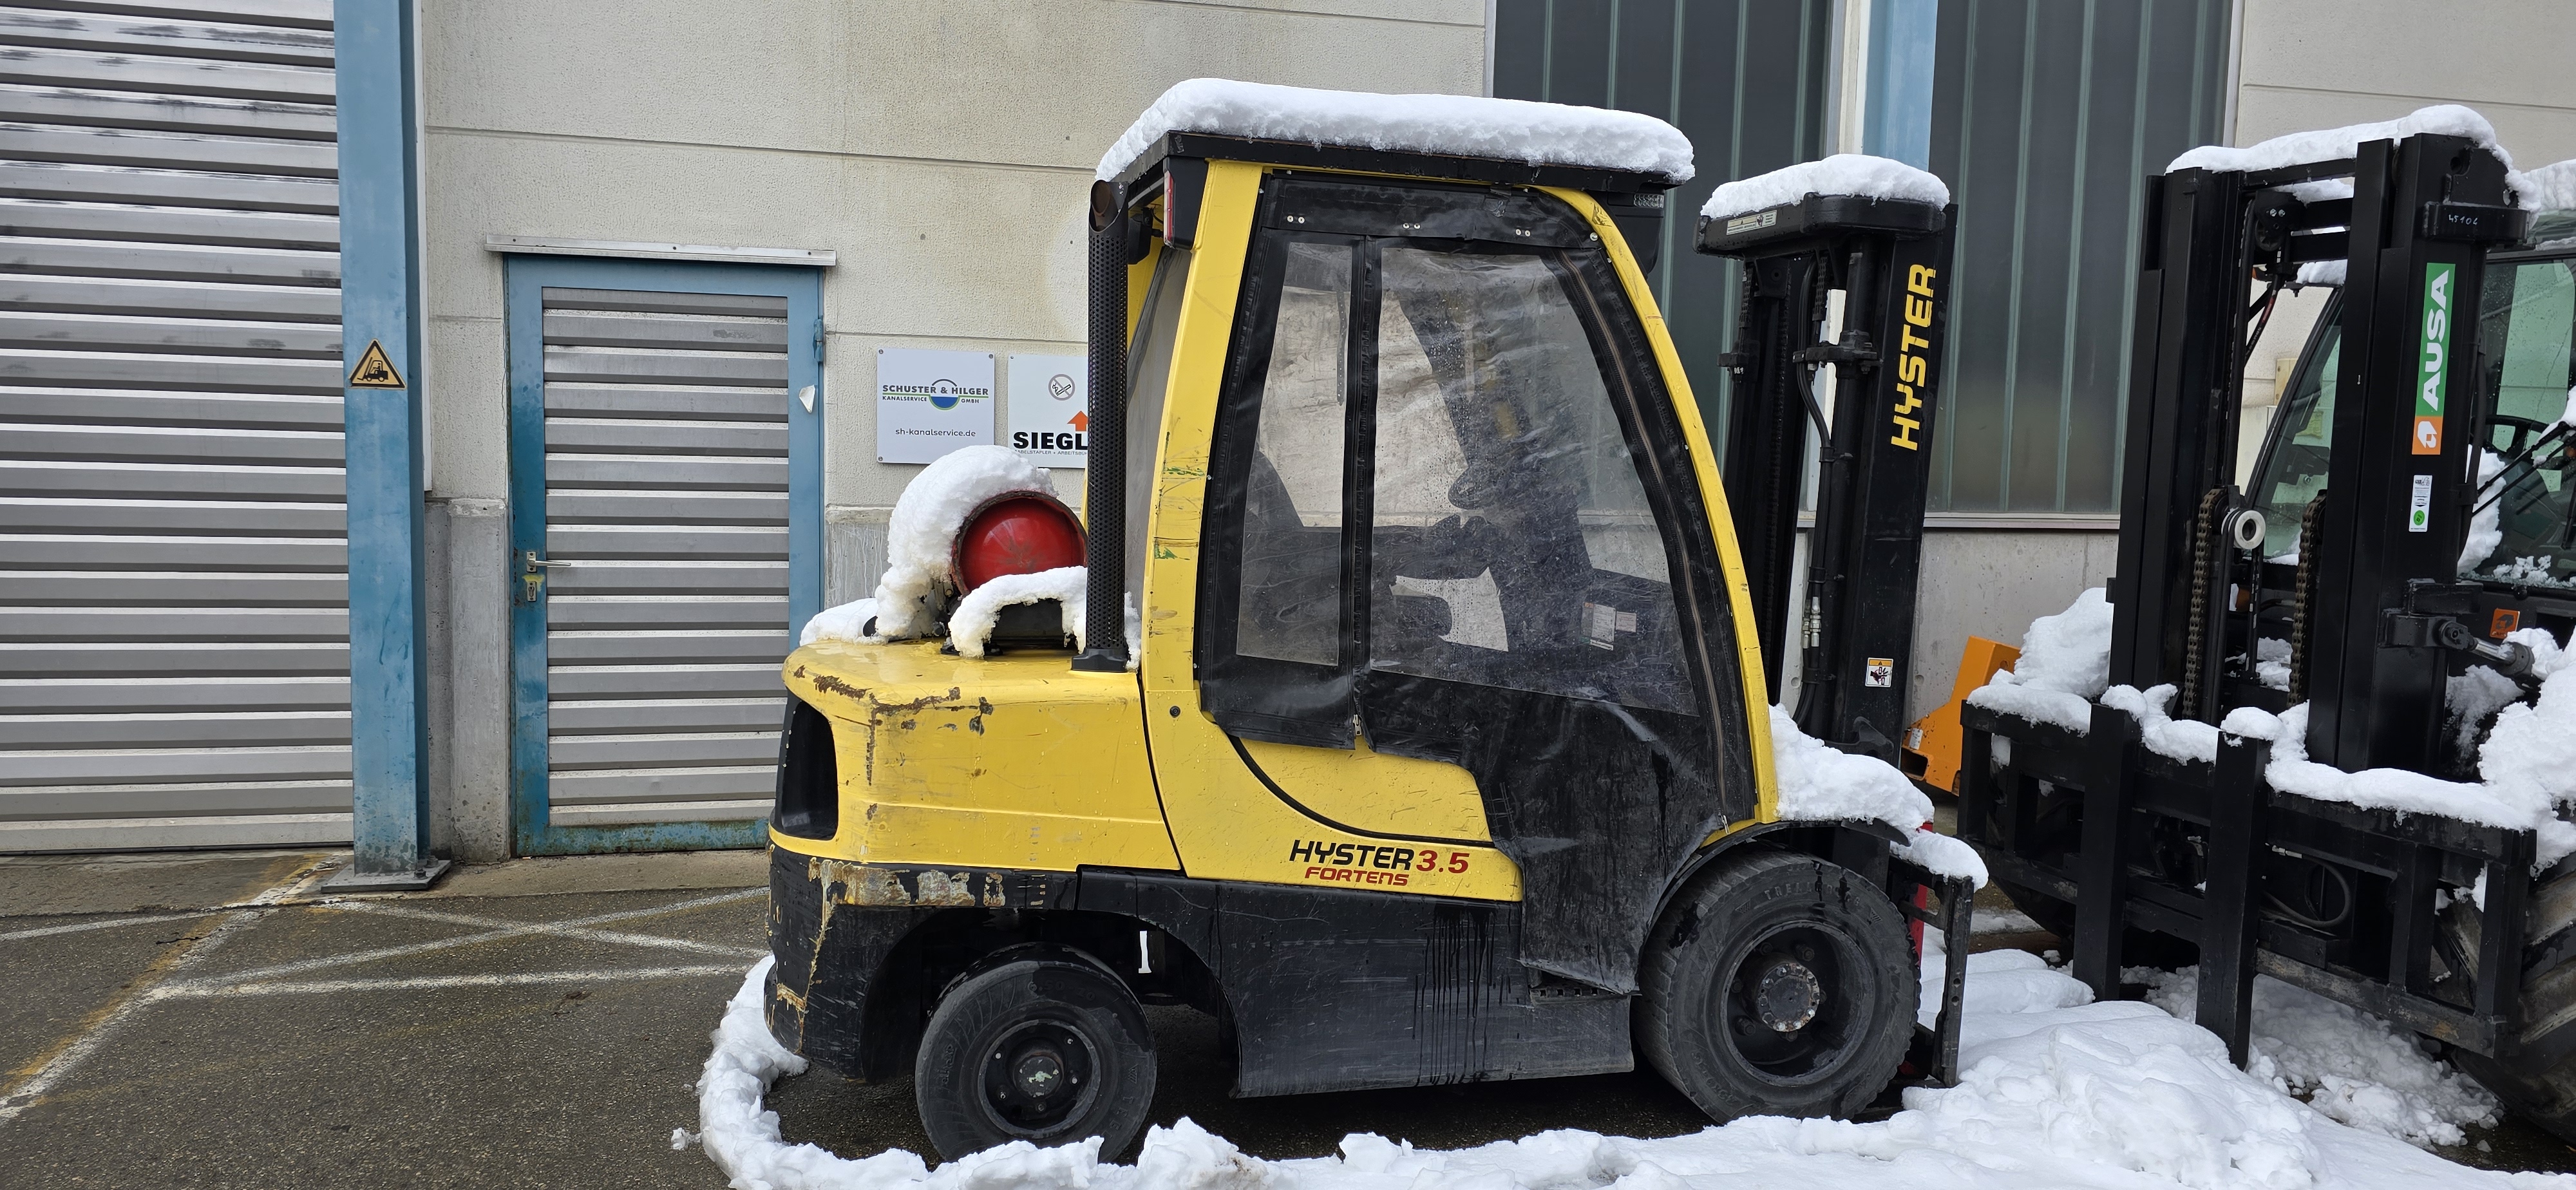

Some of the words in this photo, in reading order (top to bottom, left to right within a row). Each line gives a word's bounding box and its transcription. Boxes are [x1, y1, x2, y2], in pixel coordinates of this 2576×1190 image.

[2423, 269, 2449, 411] AUSA
[1891, 264, 1937, 451] HYSTER
[882, 384, 936, 393] SCHUSTER
[951, 387, 989, 395] HILGER
[895, 428, 976, 437] sh-kanalservice.de
[1289, 839, 1415, 871] HYSTER
[1416, 849, 1470, 874] 3.5
[1304, 867, 1410, 887] FORTENS
